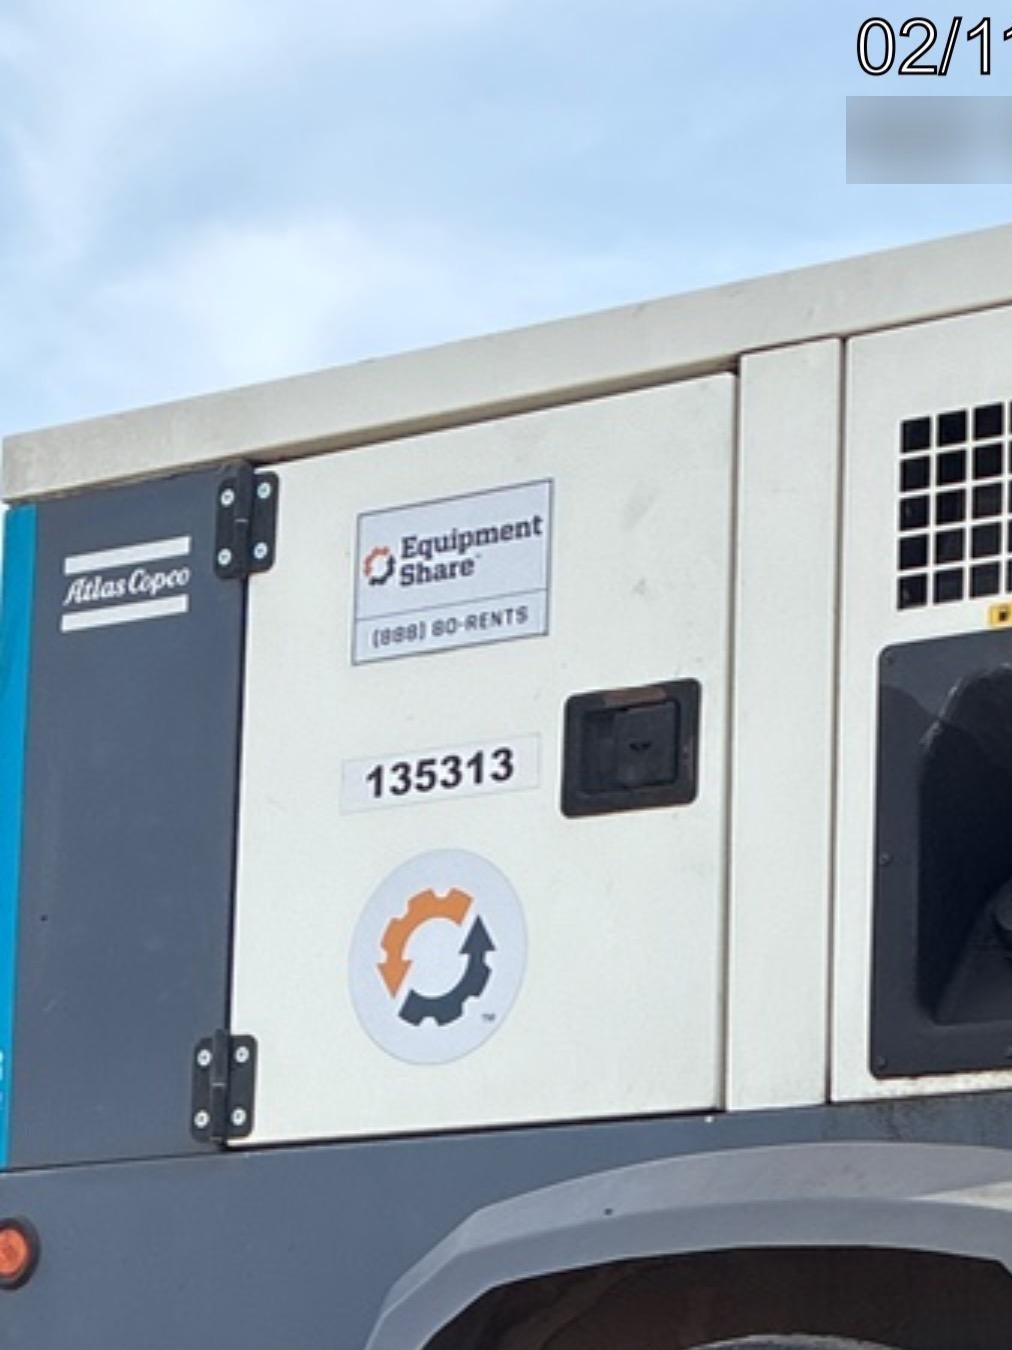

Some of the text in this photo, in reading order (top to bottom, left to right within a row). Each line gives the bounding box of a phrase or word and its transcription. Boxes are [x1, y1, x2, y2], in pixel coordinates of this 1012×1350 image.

[401, 514, 543, 560] Equipment
[62, 568, 190, 606] Atlas Copco
[399, 557, 475, 587] Share
[372, 606, 529, 648] (888) 80-RENTS
[366, 746, 514, 798] 135313
